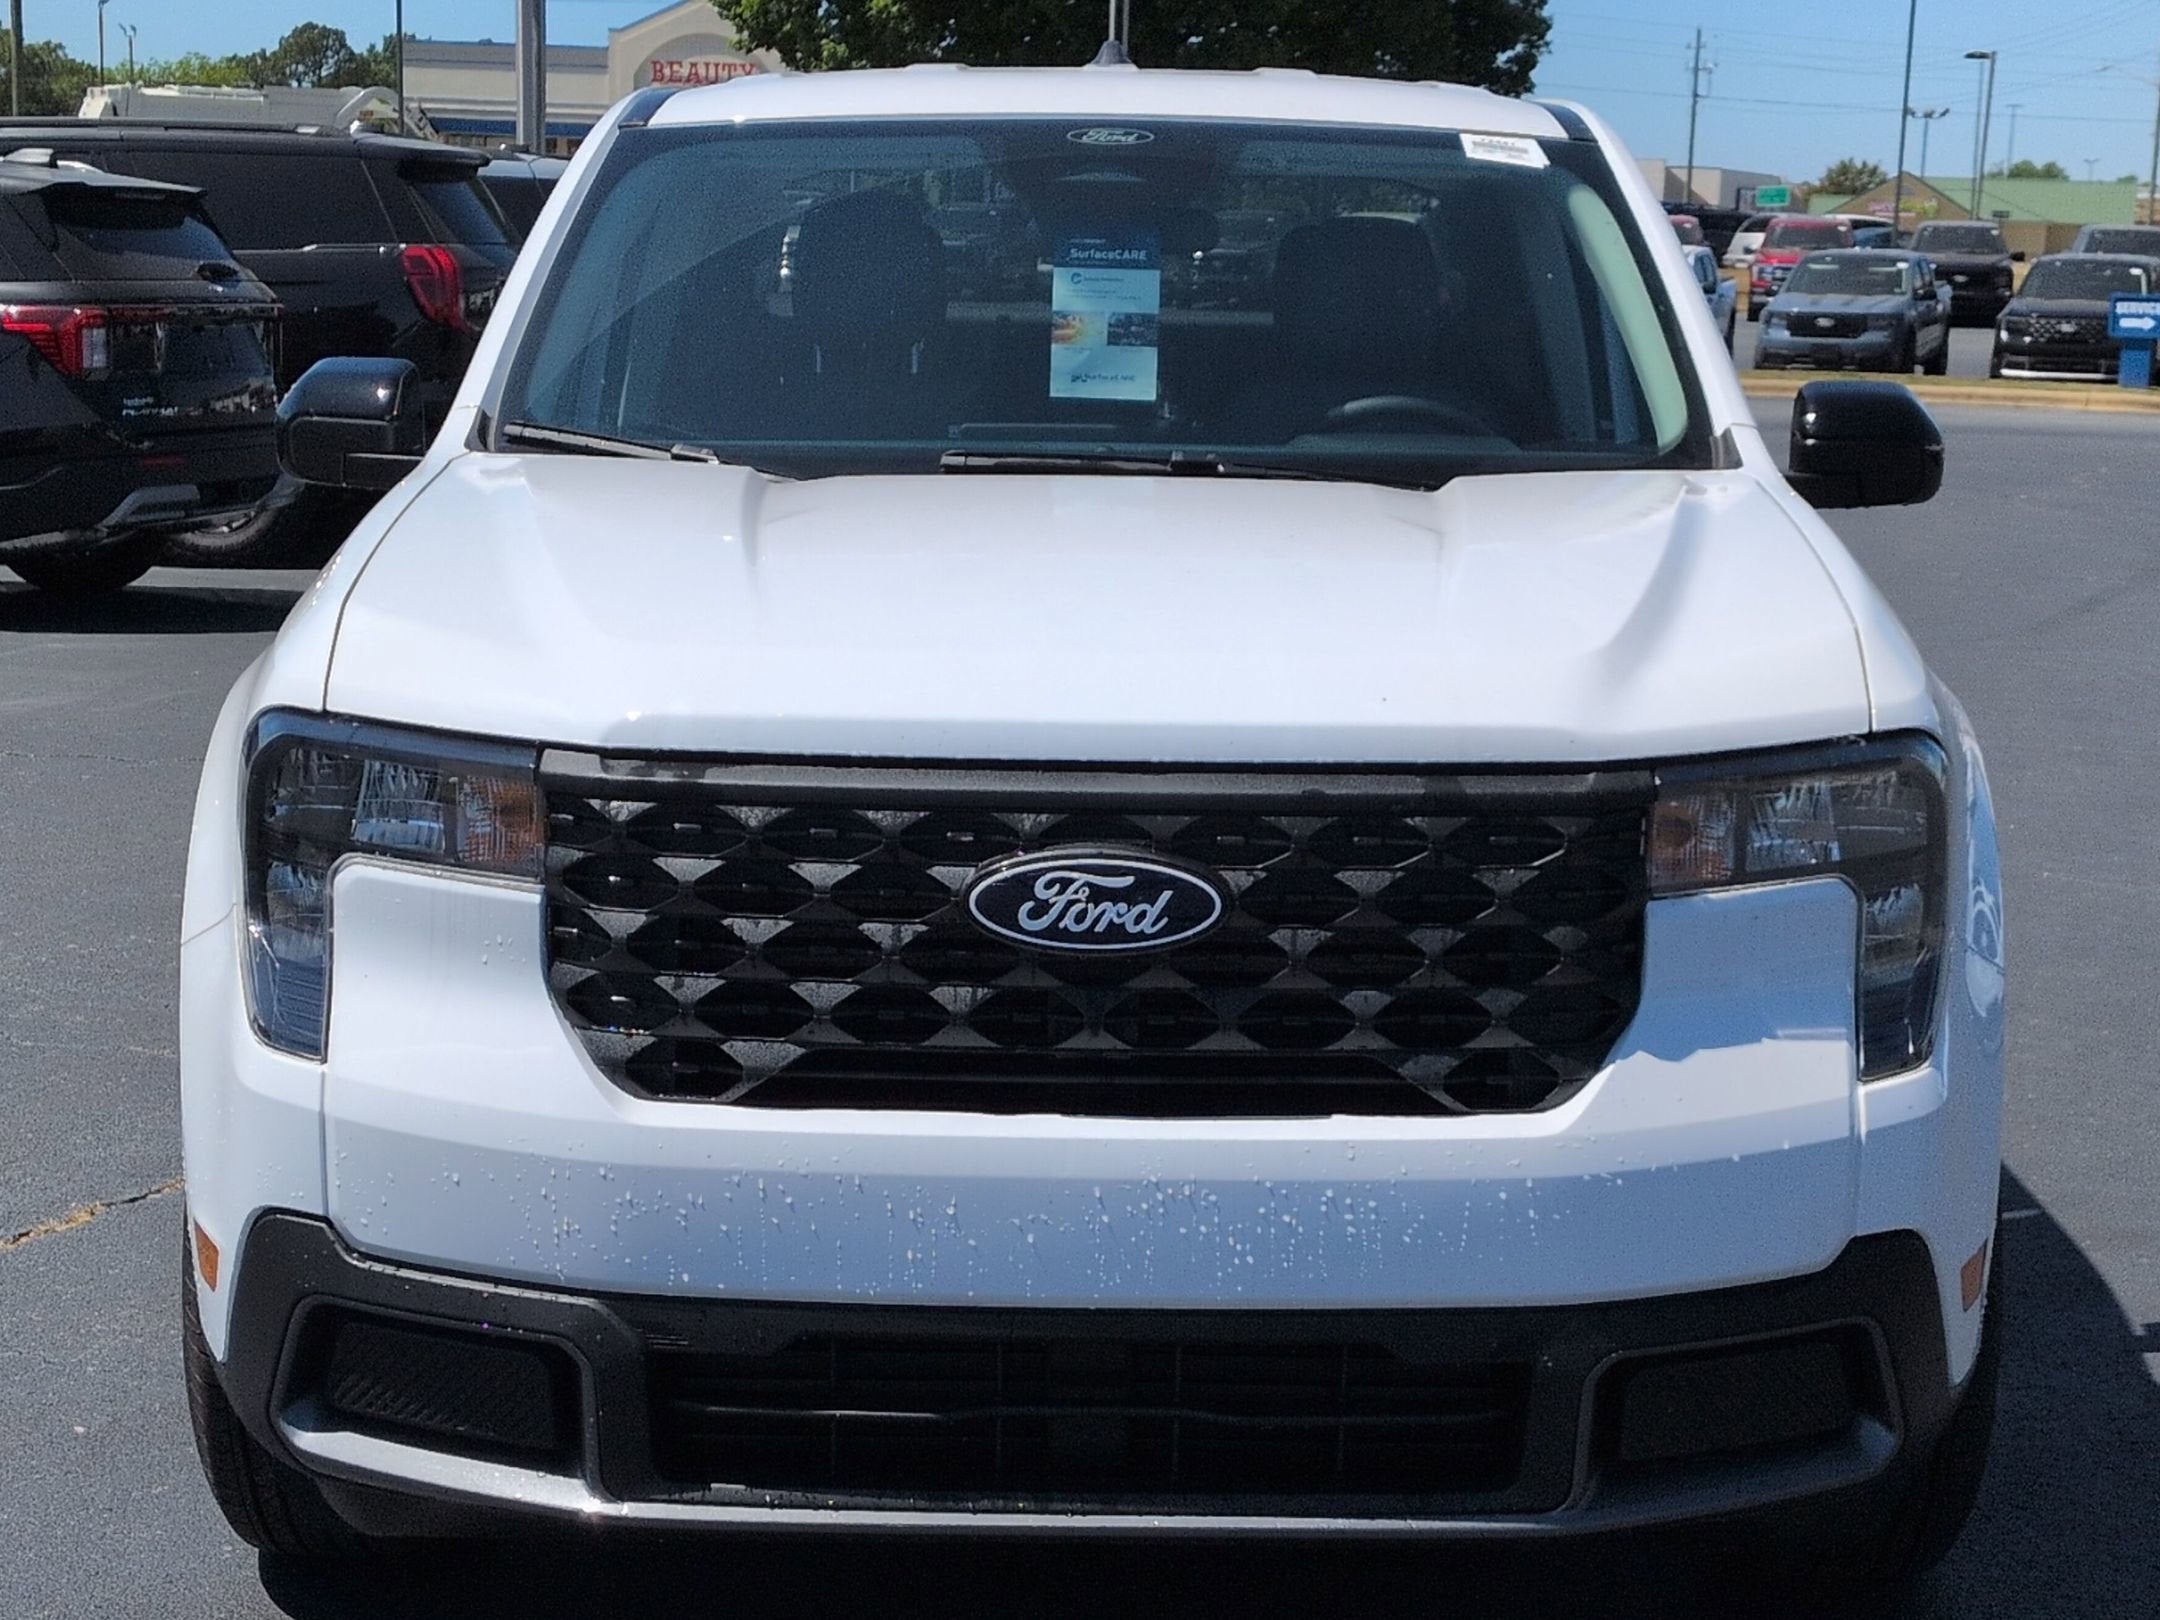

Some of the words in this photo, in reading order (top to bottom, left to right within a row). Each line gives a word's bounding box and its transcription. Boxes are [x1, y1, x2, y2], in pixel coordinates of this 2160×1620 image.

[651, 60, 758, 84] BEAUTY
[1081, 127, 1141, 143] Ford
[1069, 248, 1148, 261] SurfaceCARE
[1017, 870, 1174, 934] Ford
